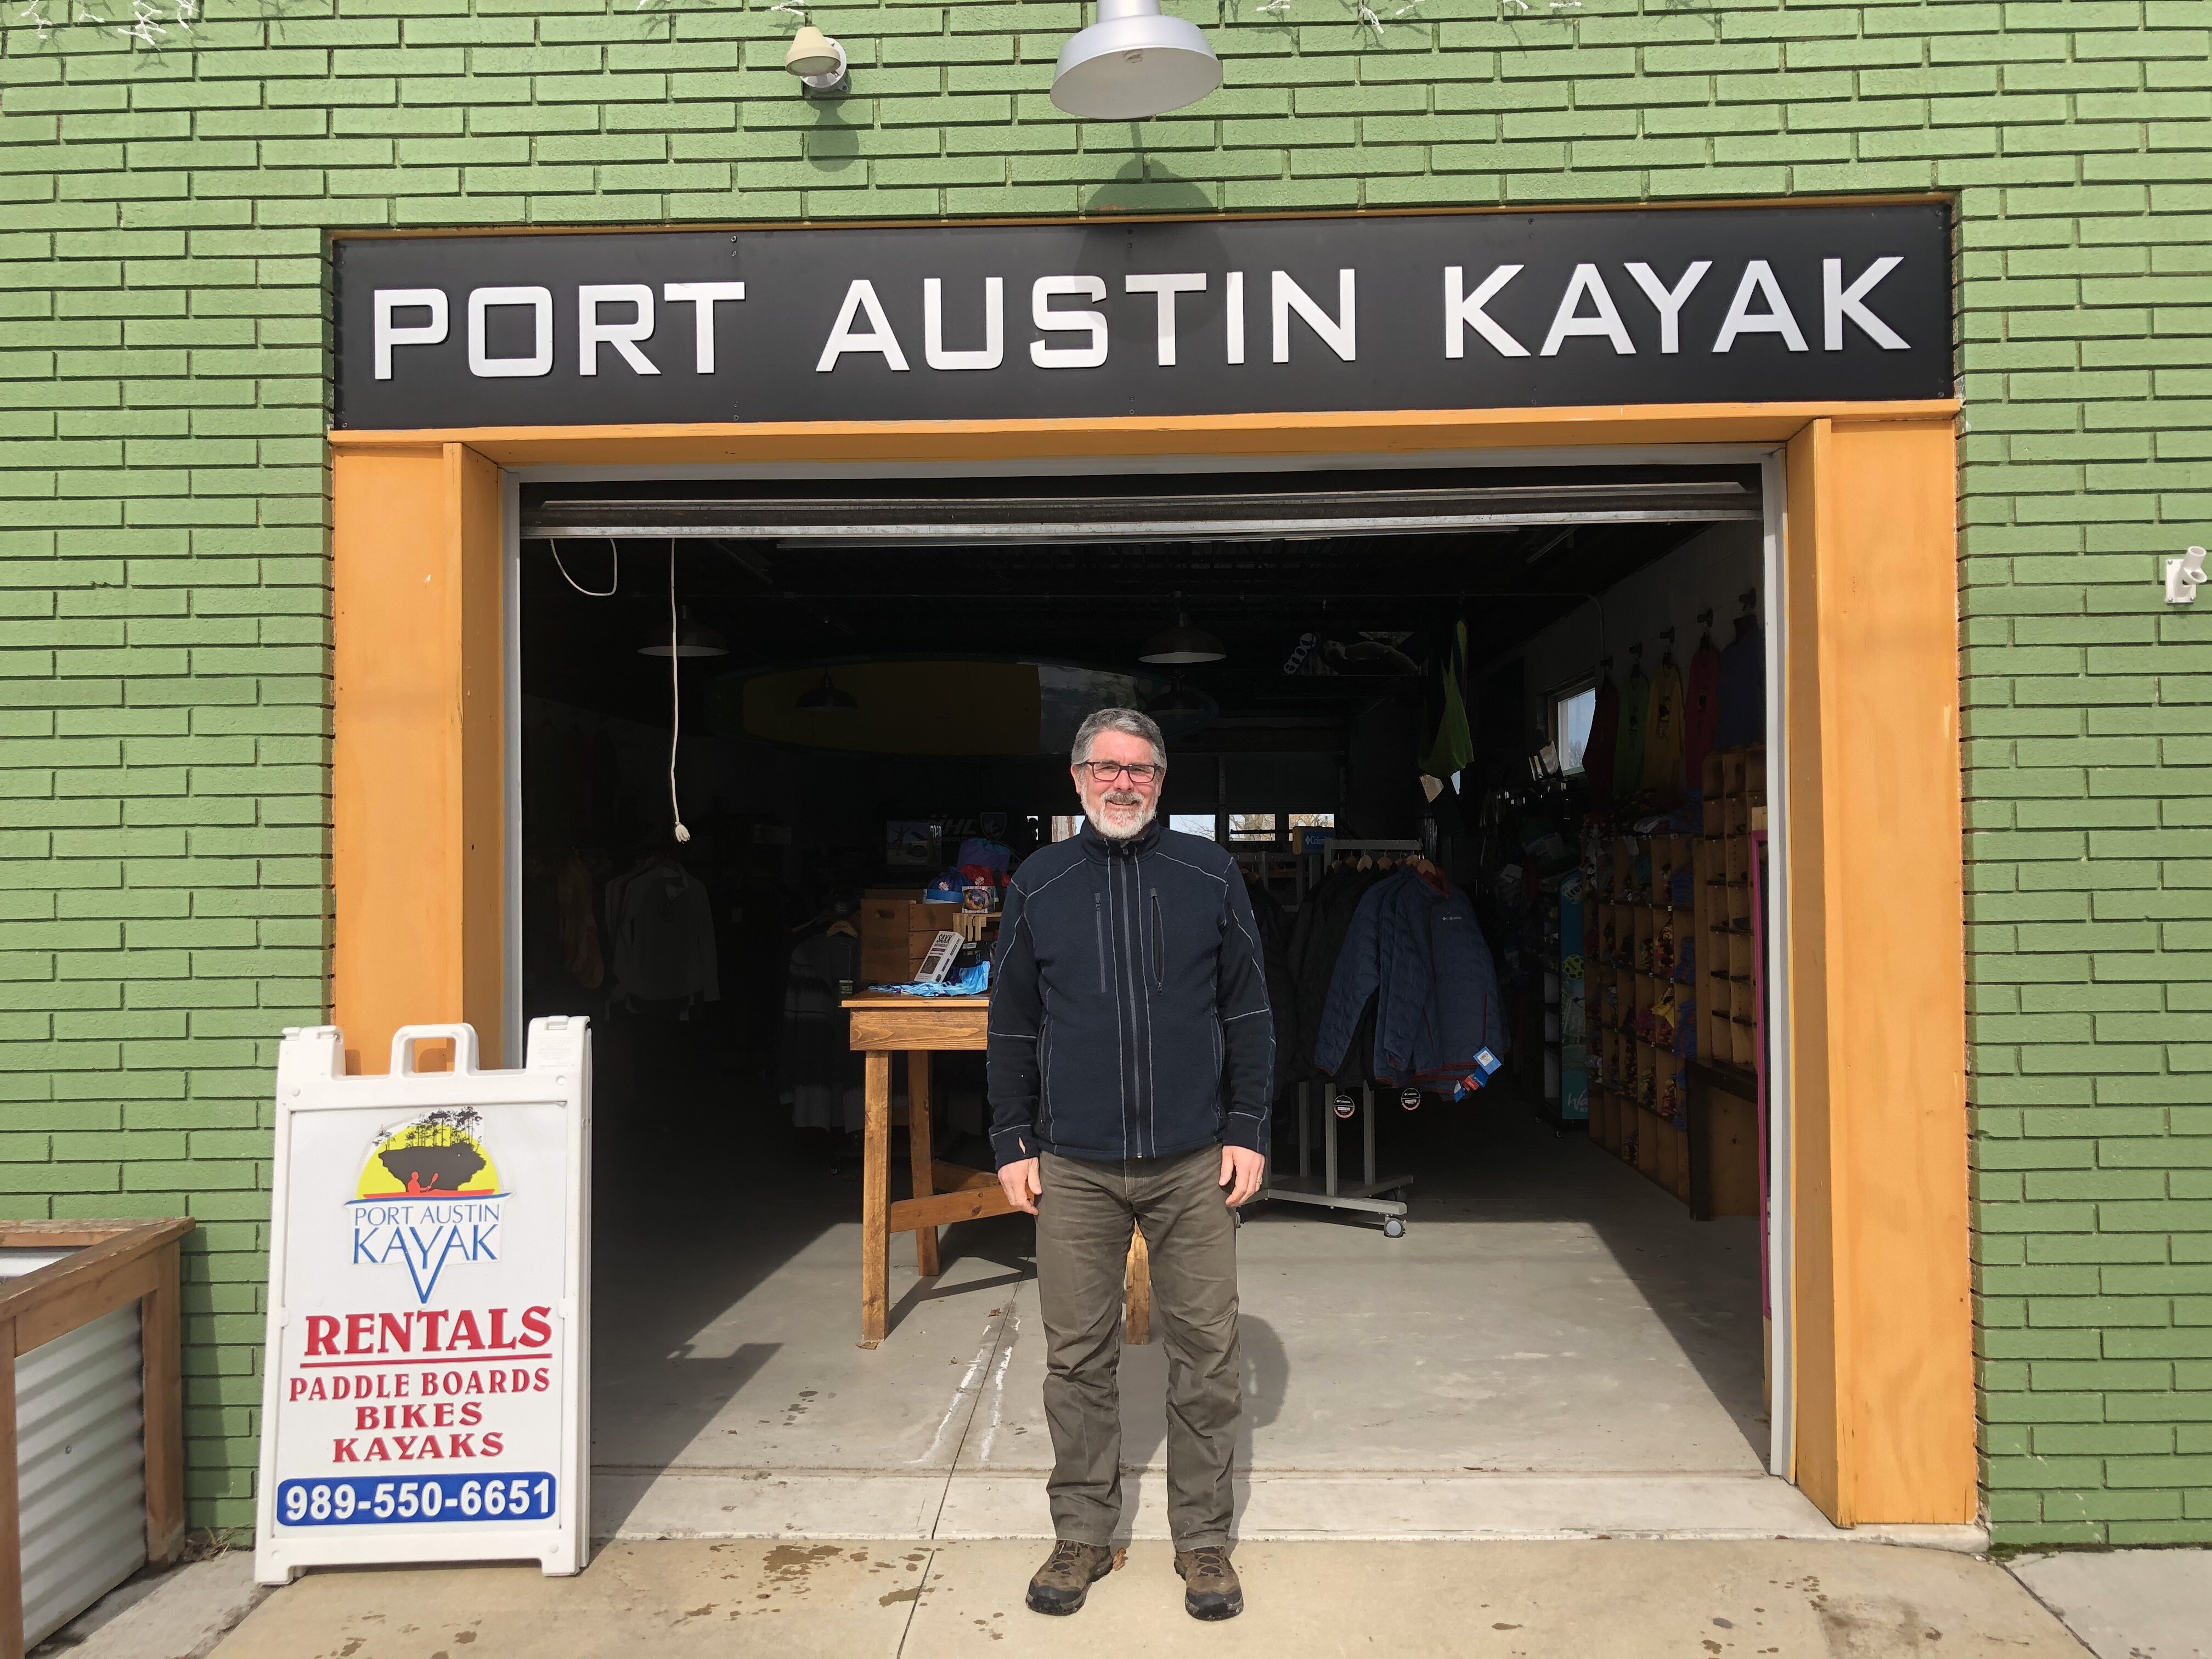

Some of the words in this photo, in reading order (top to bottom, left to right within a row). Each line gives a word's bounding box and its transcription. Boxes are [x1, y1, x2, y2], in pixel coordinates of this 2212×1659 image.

[374, 281, 745, 380] PORT
[815, 268, 1356, 373] AUSTIN
[1444, 256, 1911, 358] KAYAK
[936, 934, 953, 944] SAXX
[354, 1206, 414, 1227] PORT
[420, 1203, 500, 1224] AUSTIN
[353, 1224, 499, 1304] KAYAK
[304, 1306, 552, 1357] RENTALS
[289, 1373, 409, 1402] PADDLE
[421, 1367, 551, 1397] BOARDS
[356, 1401, 483, 1431] BIKES
[332, 1431, 504, 1464] KAYAKS
[285, 1478, 550, 1522] 989-550-6651
